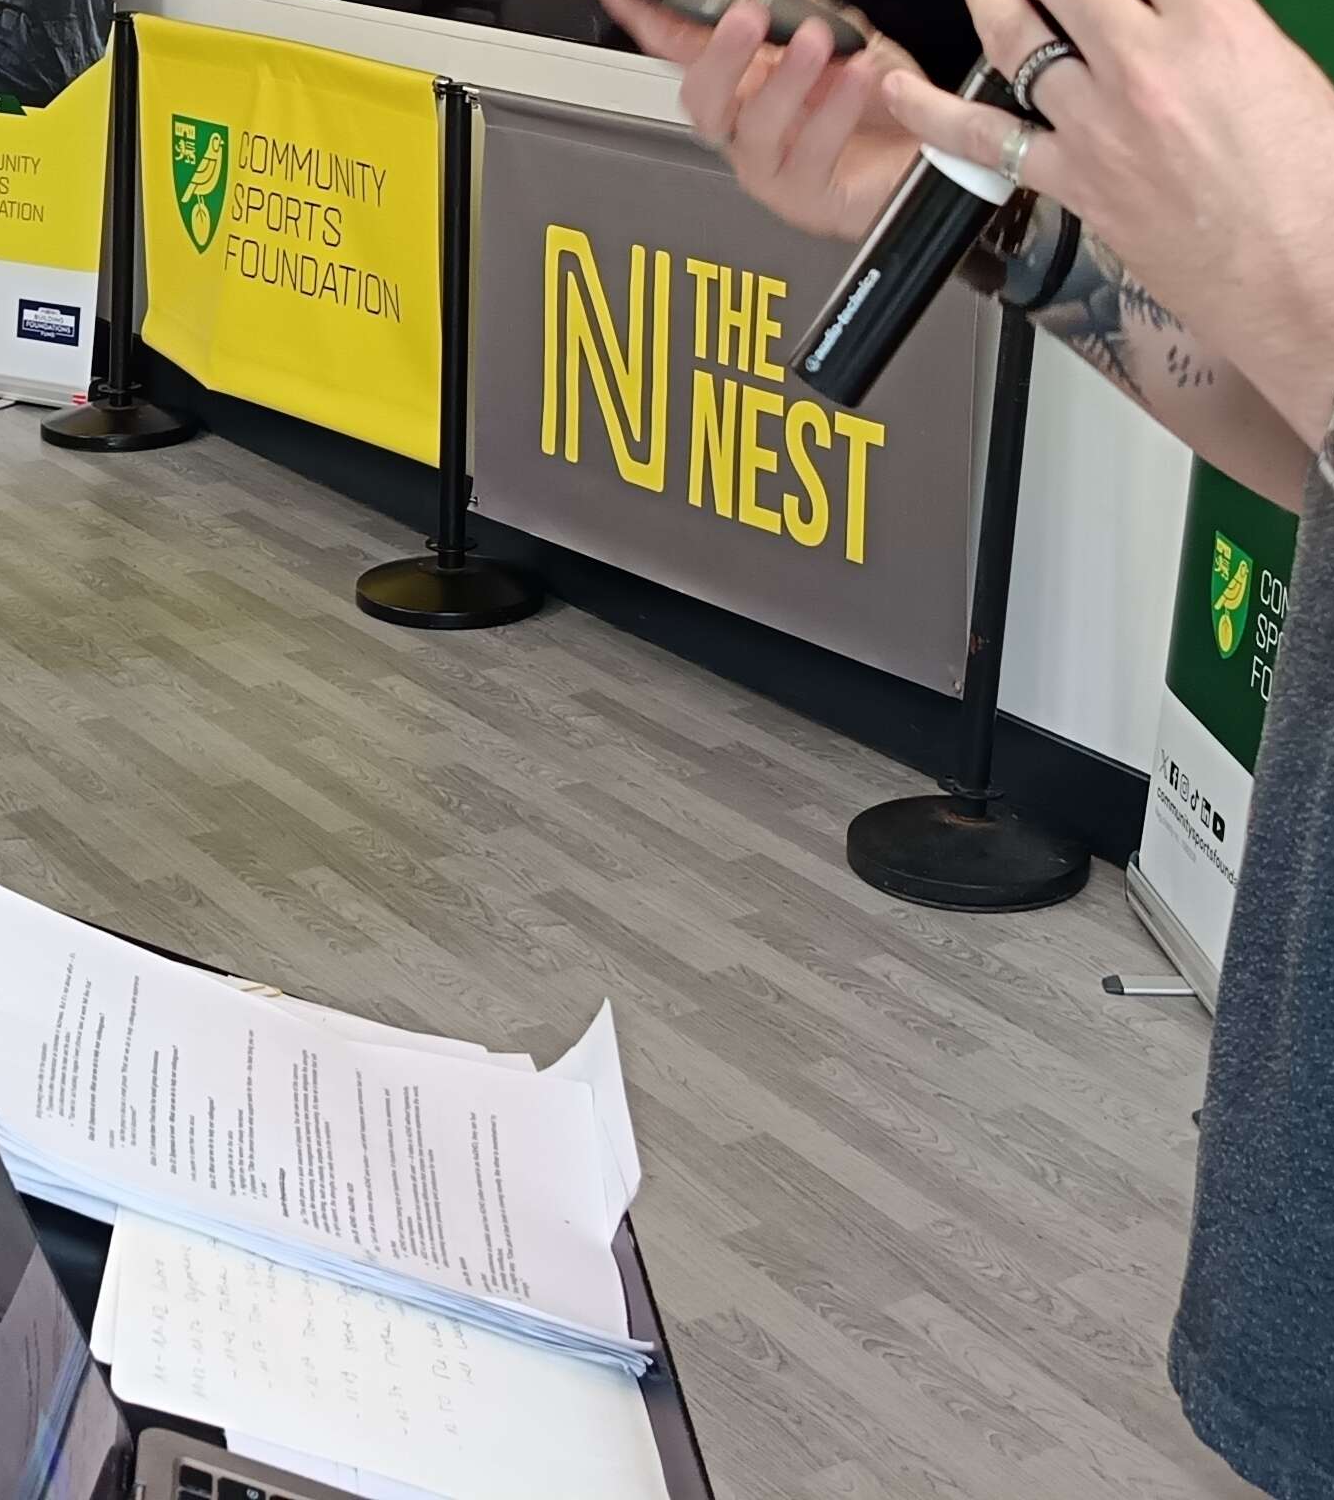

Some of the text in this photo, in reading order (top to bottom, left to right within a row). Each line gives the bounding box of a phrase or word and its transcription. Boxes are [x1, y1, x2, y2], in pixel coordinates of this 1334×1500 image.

[238, 131, 387, 207] COMMUNITY
[231, 182, 342, 247] SPORTS
[224, 234, 401, 324] FOUNDATION
[686, 258, 787, 383] THE
[688, 369, 886, 565] NEST
